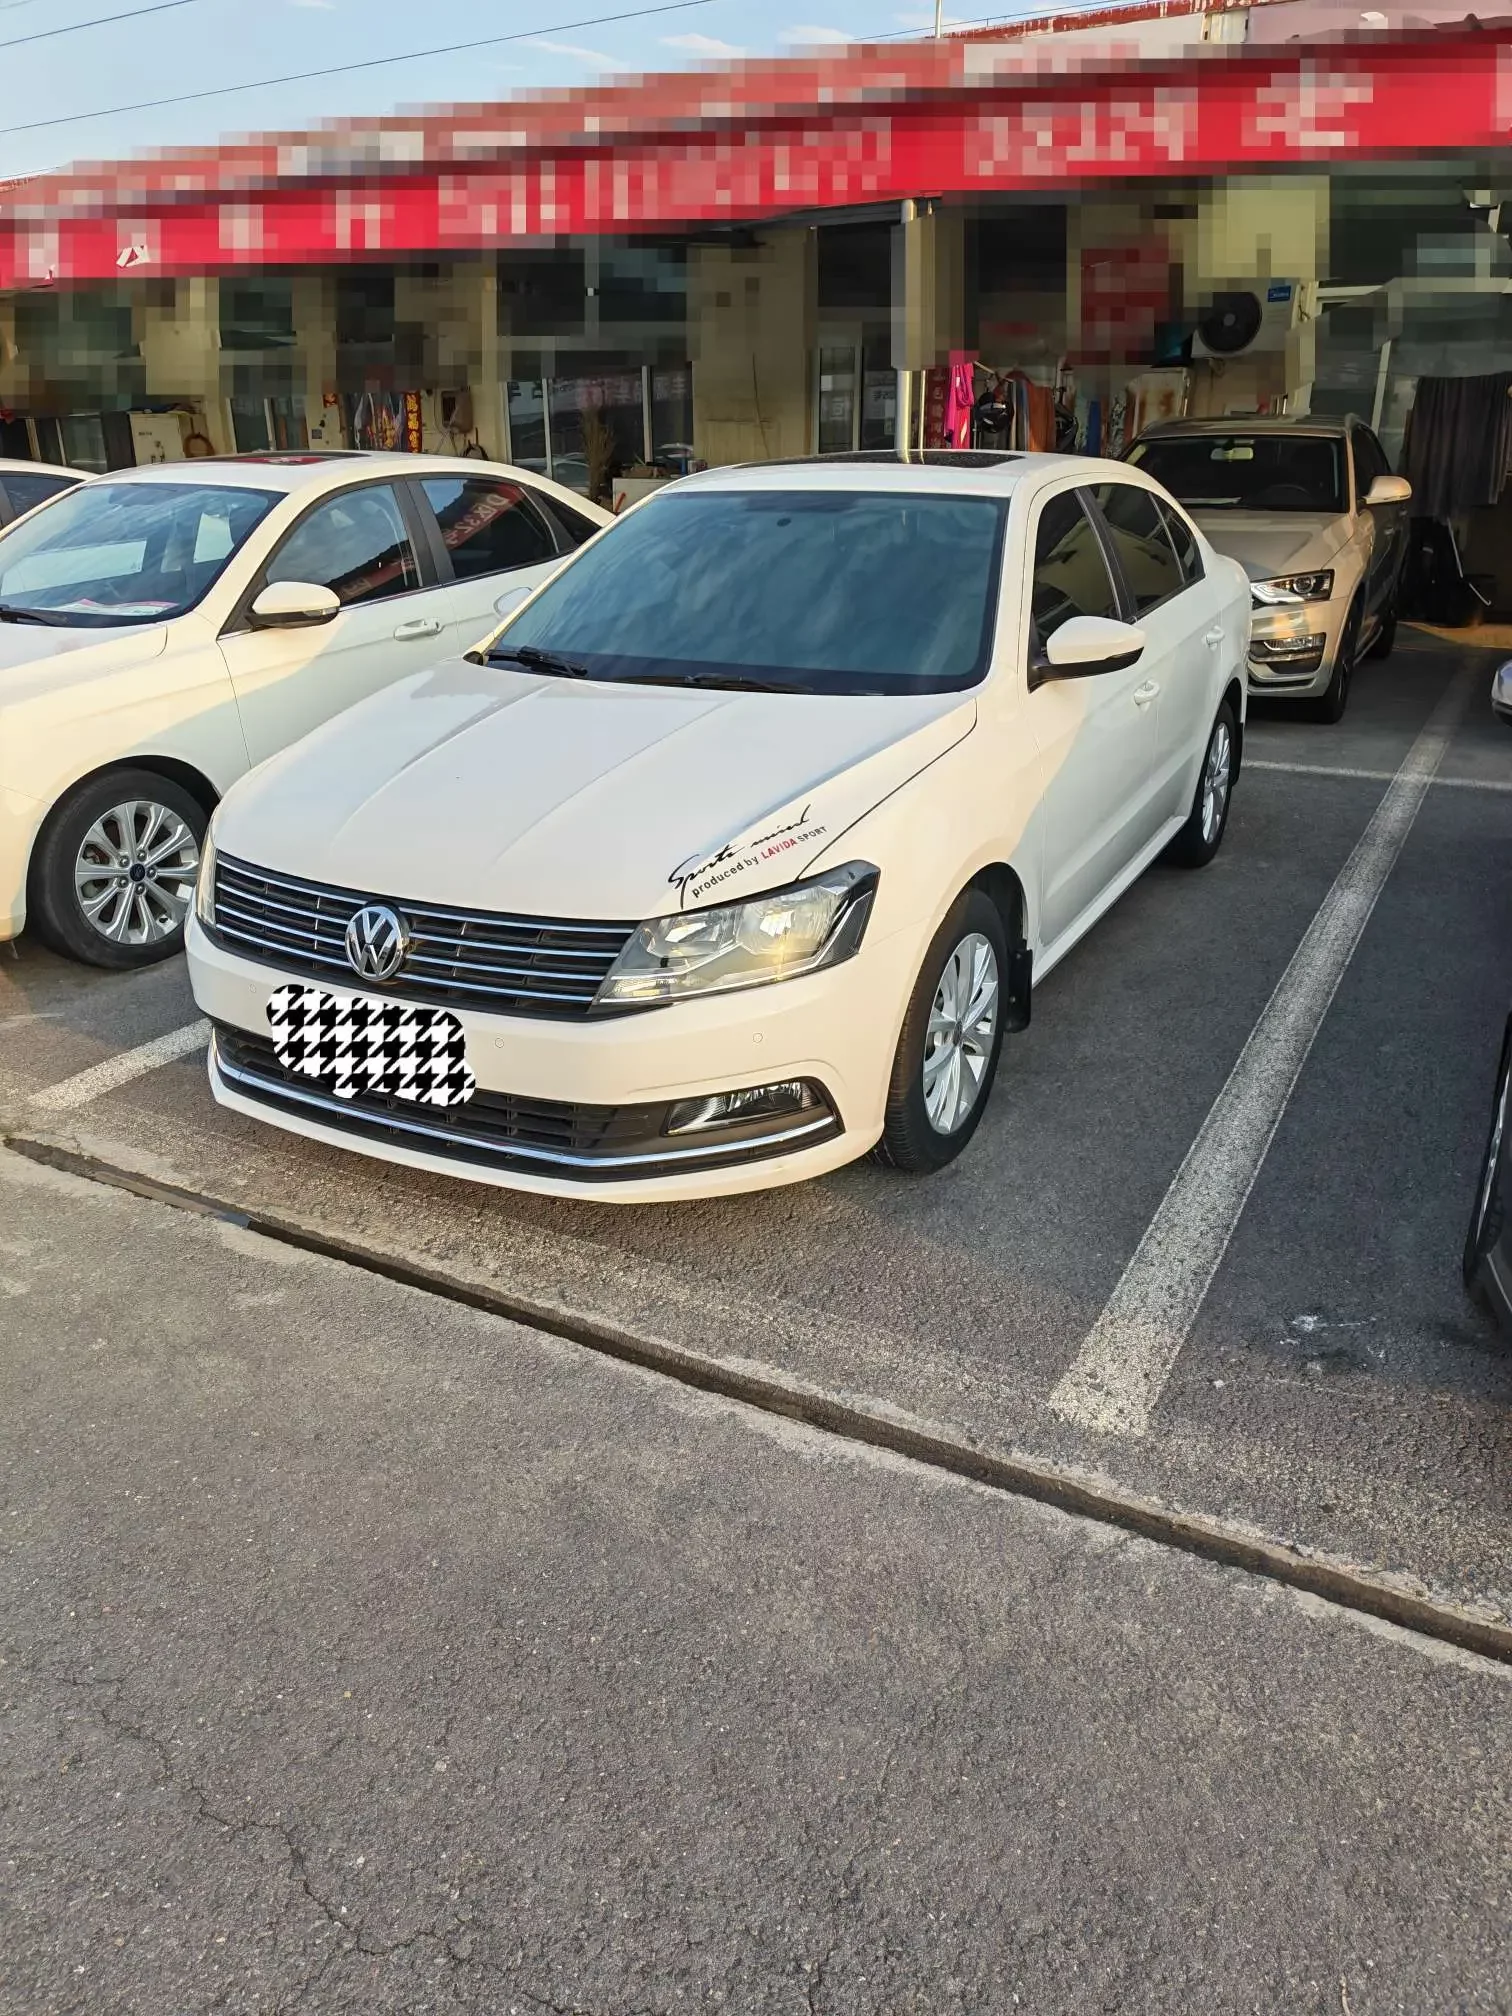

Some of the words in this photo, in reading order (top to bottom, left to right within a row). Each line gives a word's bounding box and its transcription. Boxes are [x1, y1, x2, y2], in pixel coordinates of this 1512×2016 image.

[692, 862, 745, 897] produced
[745, 856, 760, 866] by
[761, 838, 798, 859] LAVIDA
[797, 826, 827, 842] SPORT
